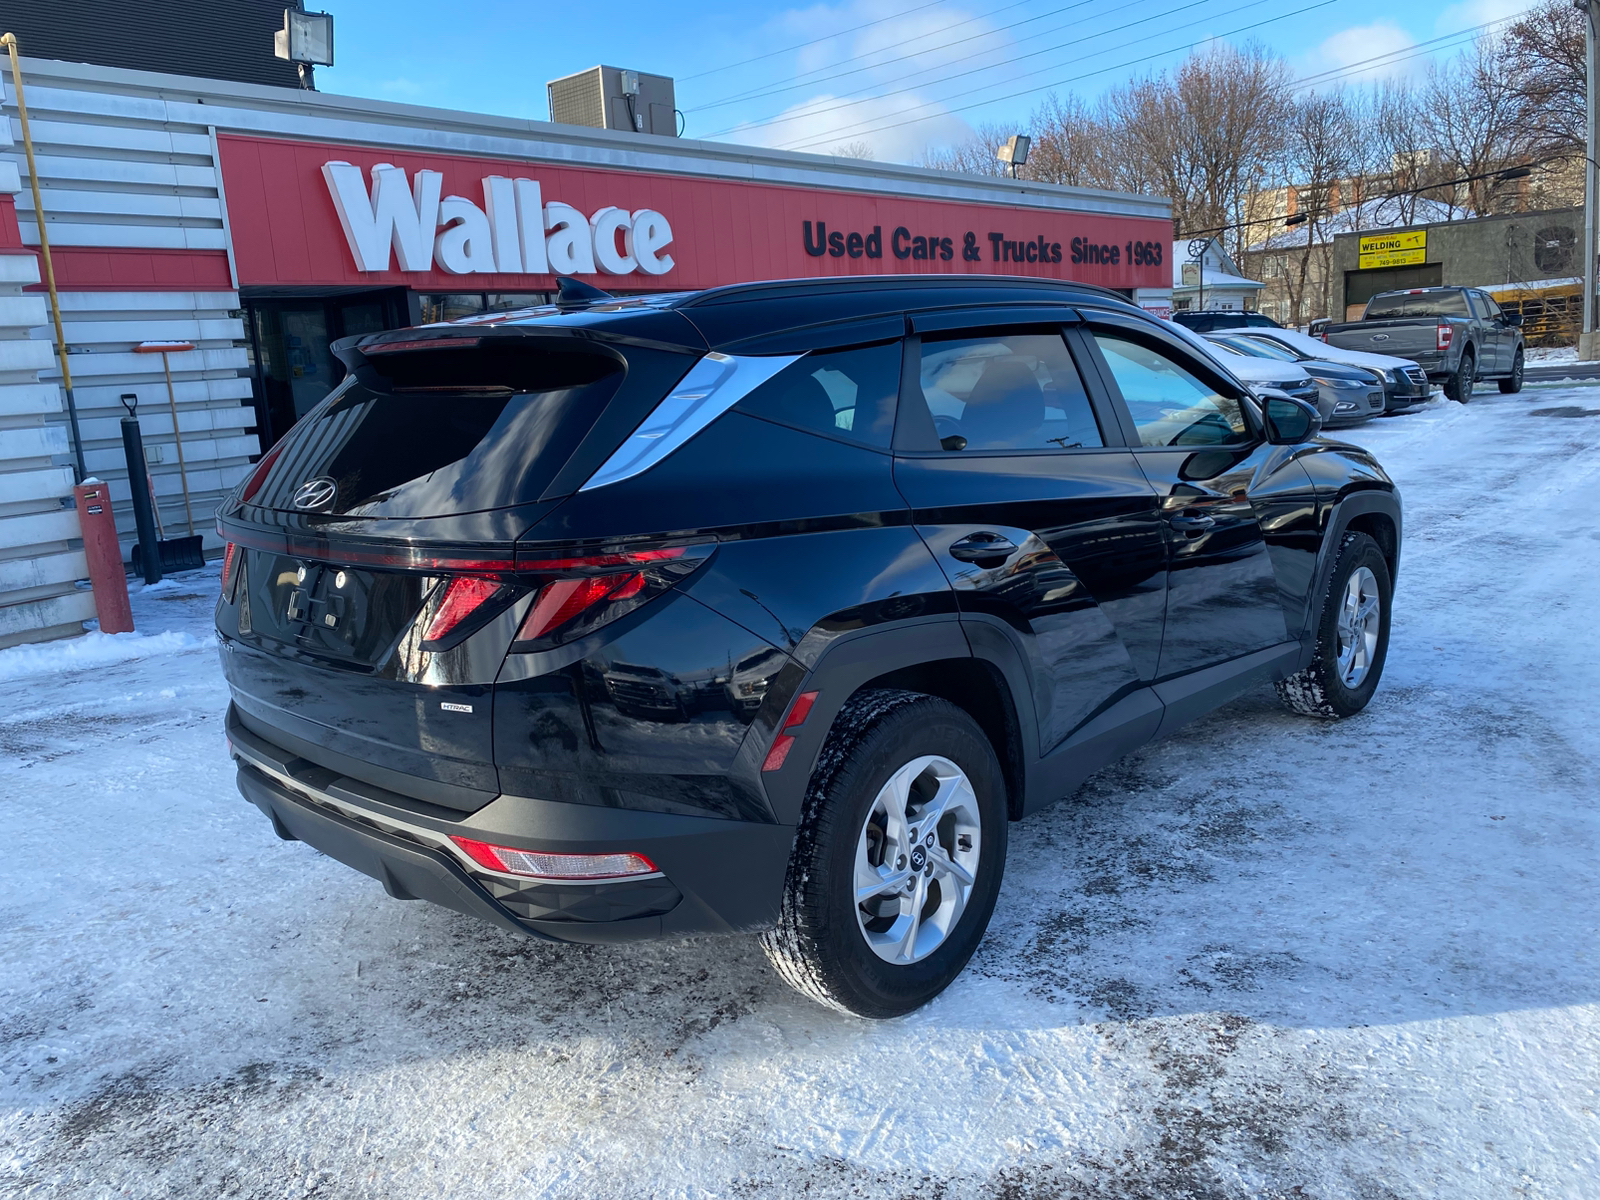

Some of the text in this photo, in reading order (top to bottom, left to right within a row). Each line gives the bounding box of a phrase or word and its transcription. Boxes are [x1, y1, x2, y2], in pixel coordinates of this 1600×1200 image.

[321, 161, 675, 275] Wallace
[802, 220, 1162, 266] Used Cars & Trucks Since 1963
[1362, 240, 1401, 251] WELDING
